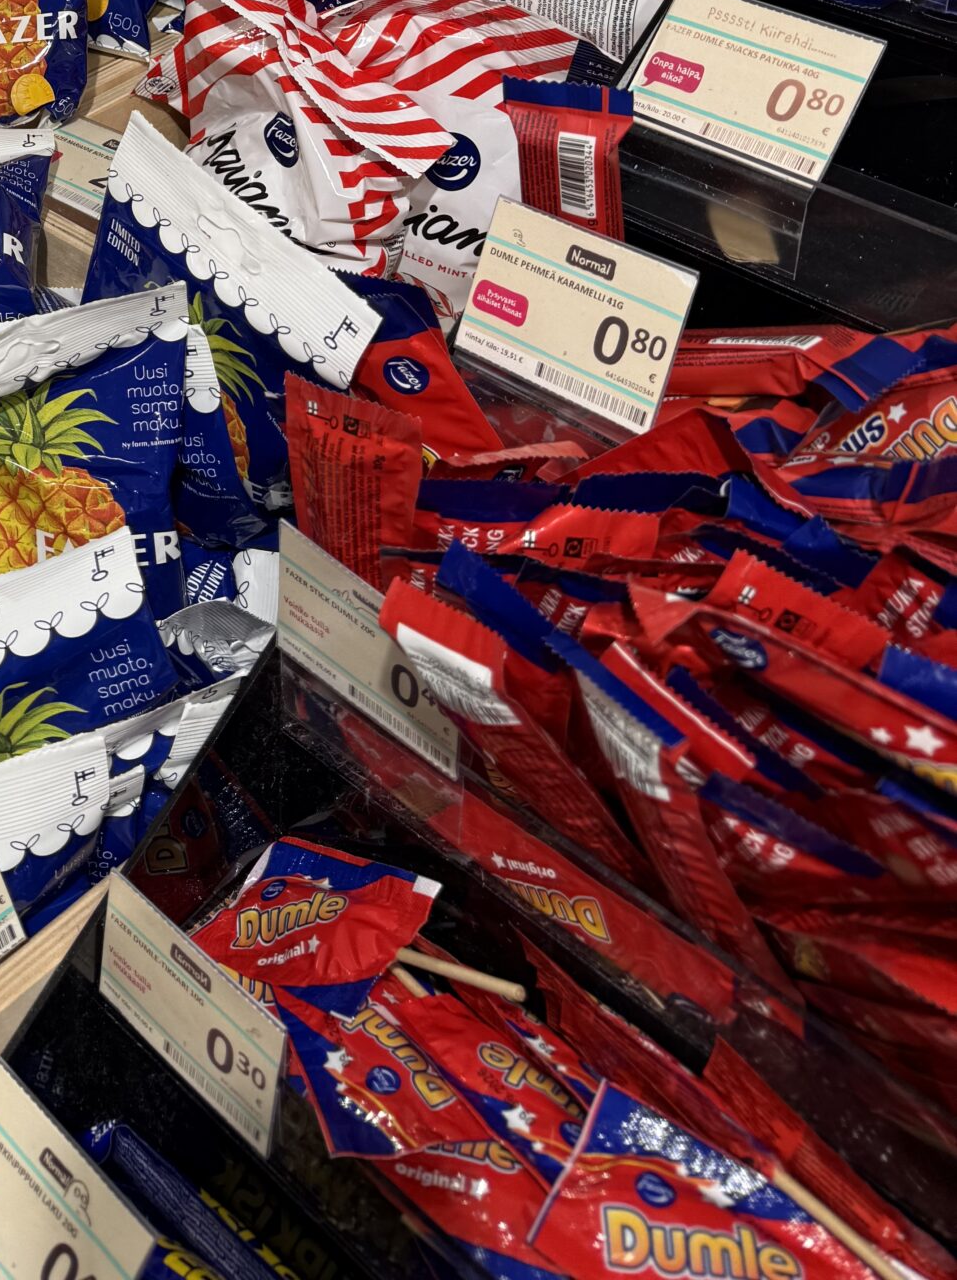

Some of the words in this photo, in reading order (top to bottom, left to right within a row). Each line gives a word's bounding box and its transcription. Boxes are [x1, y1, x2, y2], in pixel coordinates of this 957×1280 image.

[107, 11, 141, 37] 150g
[666, 23, 692, 38] FAZER
[693, 30, 724, 48] DUMLE
[725, 41, 759, 59] SNACKS
[759, 51, 801, 73] PATUKKA
[802, 66, 820, 79] 40G
[652, 55, 674, 71] Onpa
[676, 63, 701, 81] halpa,
[107, 231, 140, 267] EDITION
[111, 219, 141, 253] LIMITED
[570, 248, 612, 275] Normal
[490, 247, 520, 266] DUMLE
[520, 259, 556, 282] PEHMEÄ
[557, 275, 606, 302] KARAMELLI
[606, 297, 624, 311] 41G
[134, 366, 168, 380] Uusi
[388, 357, 424, 391] Fazer
[648, 373, 657, 384] €
[127, 383, 183, 397] muoto,
[131, 399, 178, 414] sama
[133, 416, 181, 434] maku.
[89, 639, 131, 662] Uusi
[89, 657, 153, 682] muoto,
[97, 674, 150, 699] sama
[103, 688, 159, 716] maku.
[233, 892, 348, 950] Dumle
[257, 941, 305, 967] original
[43, 1152, 74, 1187] Normal
[395, 1162, 466, 1193] original
[600, 1203, 803, 1280] Dumle
